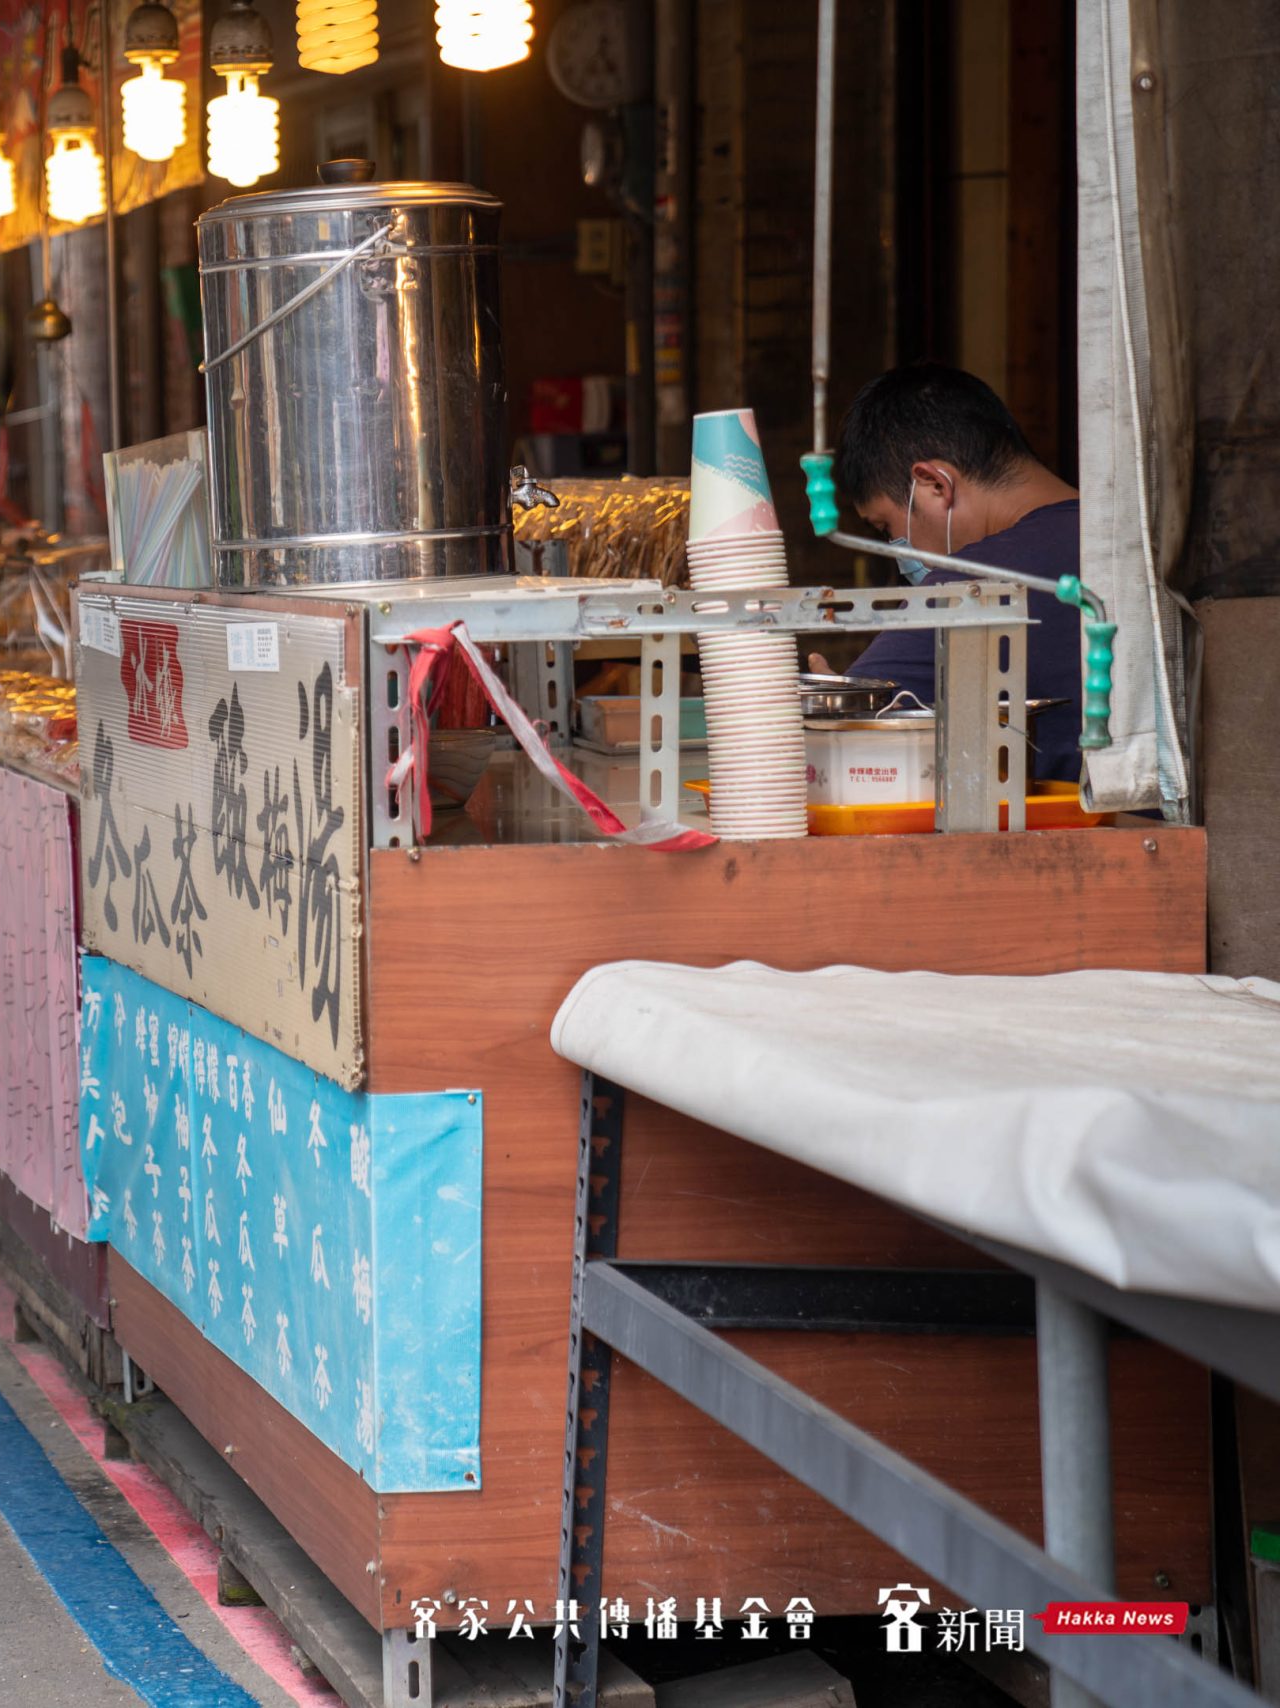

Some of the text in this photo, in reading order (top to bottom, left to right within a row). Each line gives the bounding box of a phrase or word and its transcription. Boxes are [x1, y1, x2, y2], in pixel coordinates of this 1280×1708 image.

[88, 719, 207, 980] 冬瓜茶
[208, 660, 344, 1050] 酸梅湯
[193, 1036, 222, 1319] 檸檬冬瓜茶
[226, 1054, 256, 1346] 百香冬瓜茶
[267, 1076, 293, 1377] 仙草茶
[308, 1099, 332, 1410] 冬瓜茶
[350, 1123, 373, 1455] 酸梅湯
